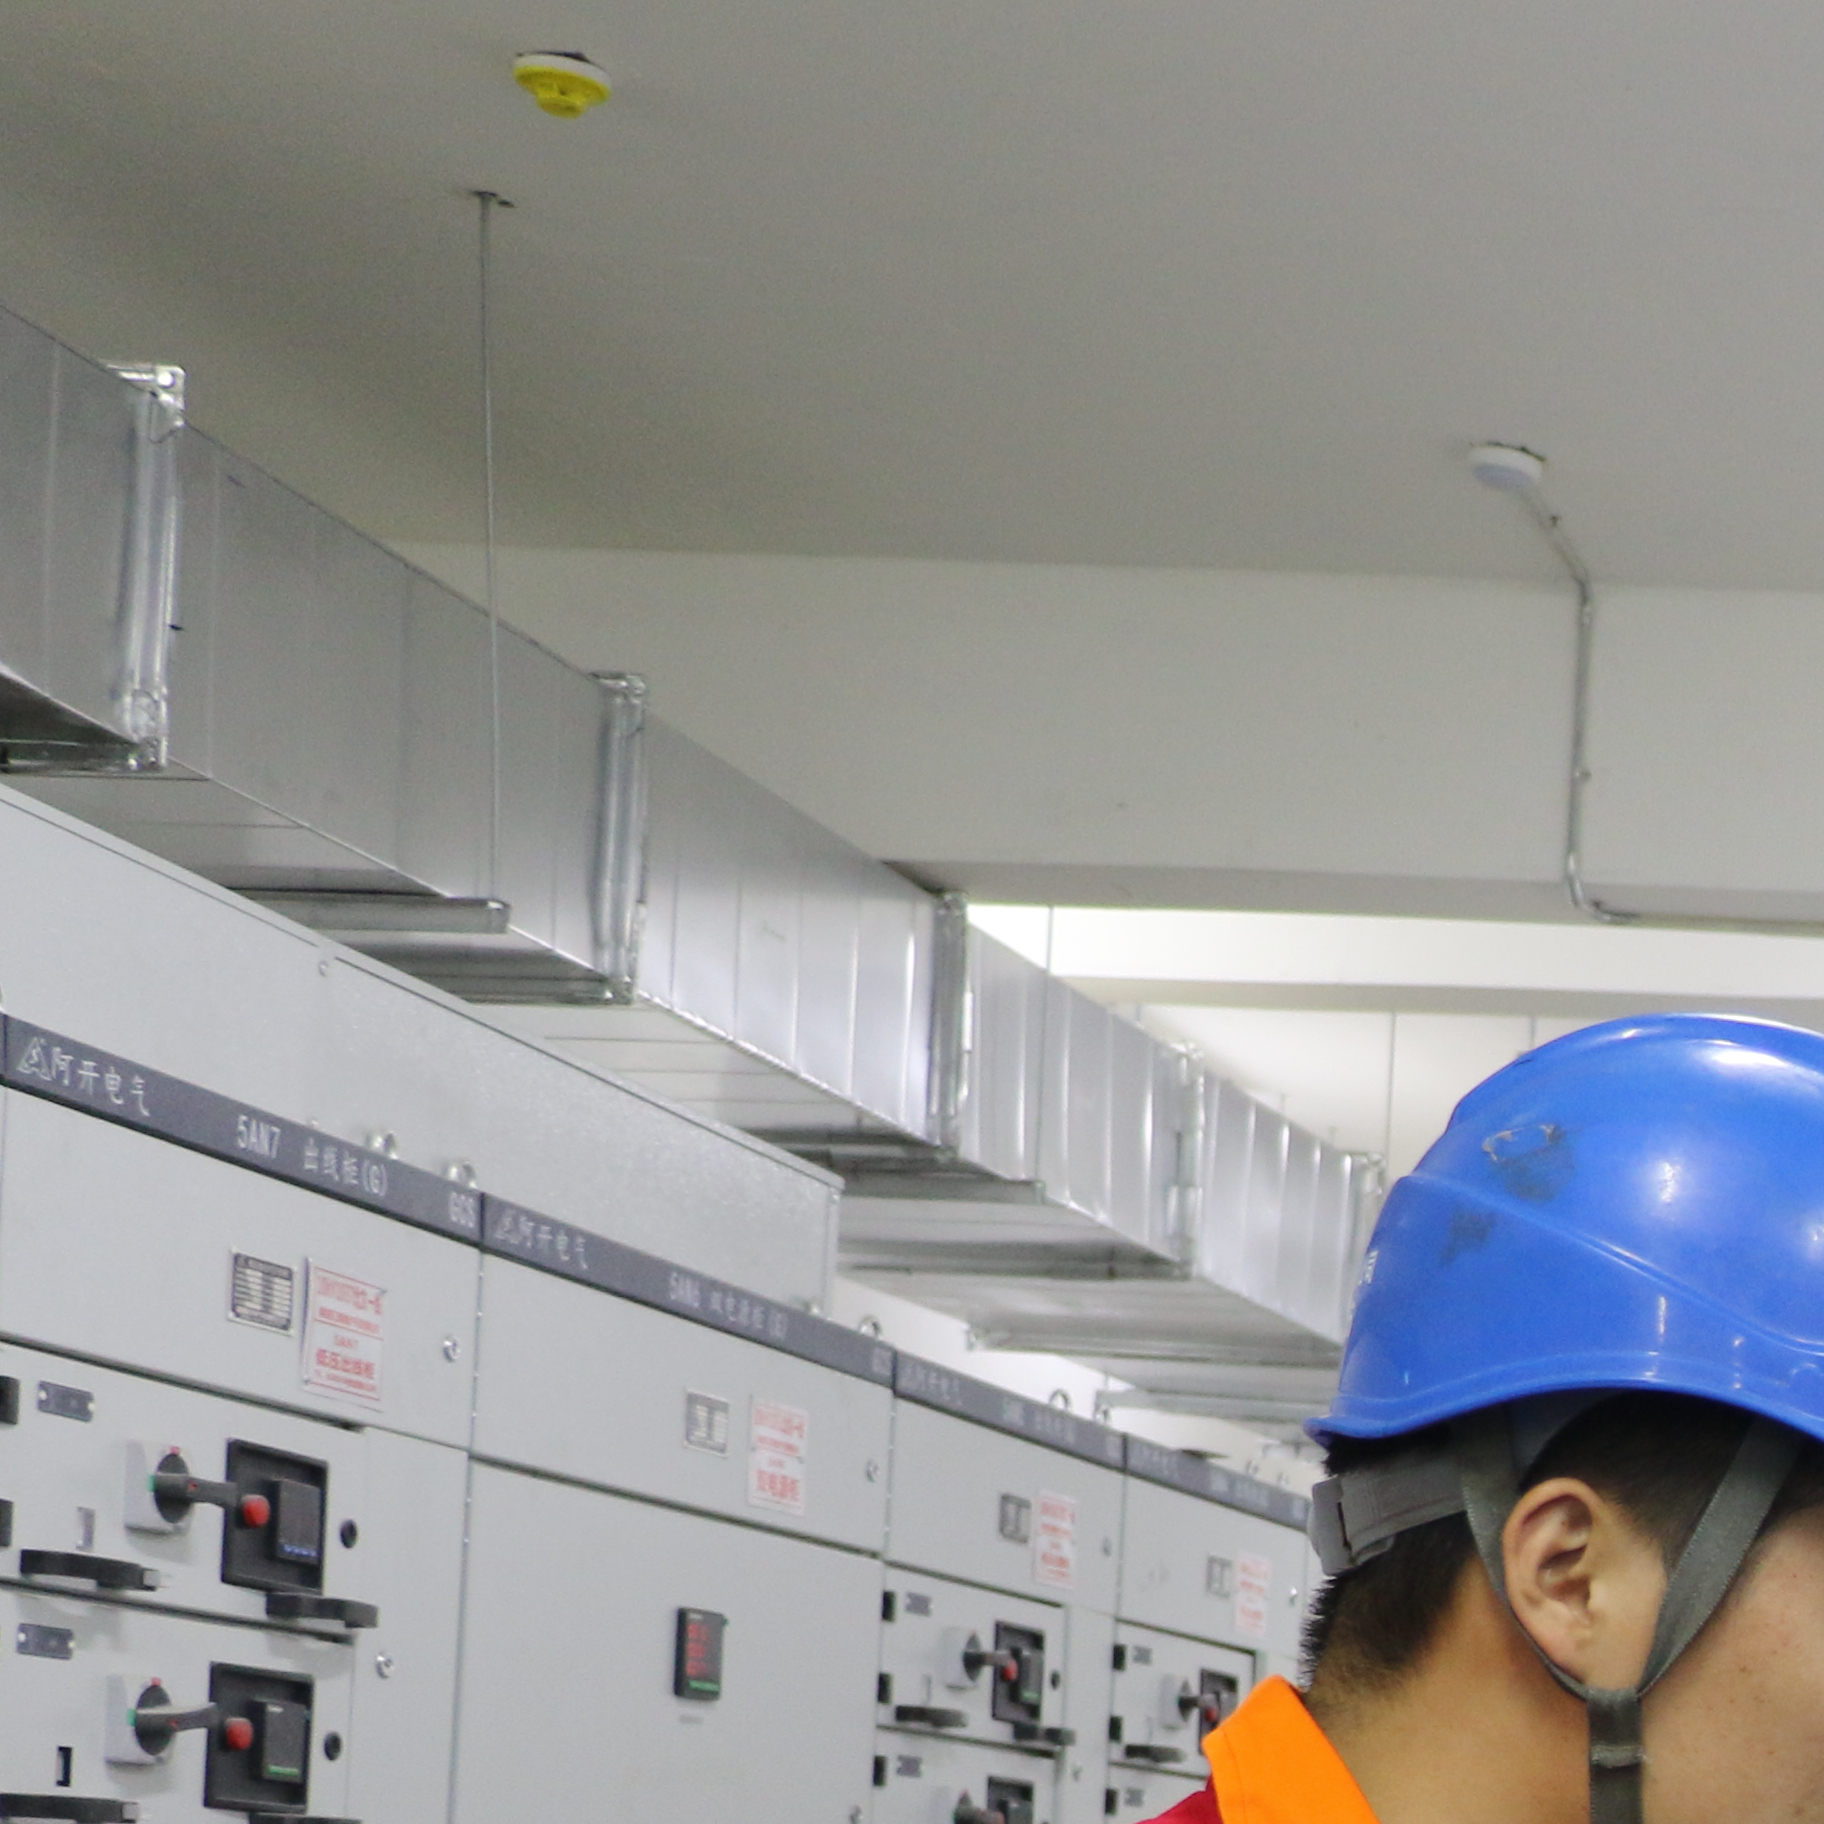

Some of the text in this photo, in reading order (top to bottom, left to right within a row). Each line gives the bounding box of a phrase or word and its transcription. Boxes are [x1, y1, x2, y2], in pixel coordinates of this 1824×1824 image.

[51, 1046, 151, 1118] 阿开电气
[236, 1114, 282, 1160] 5AN7
[448, 1192, 477, 1229] GCS
